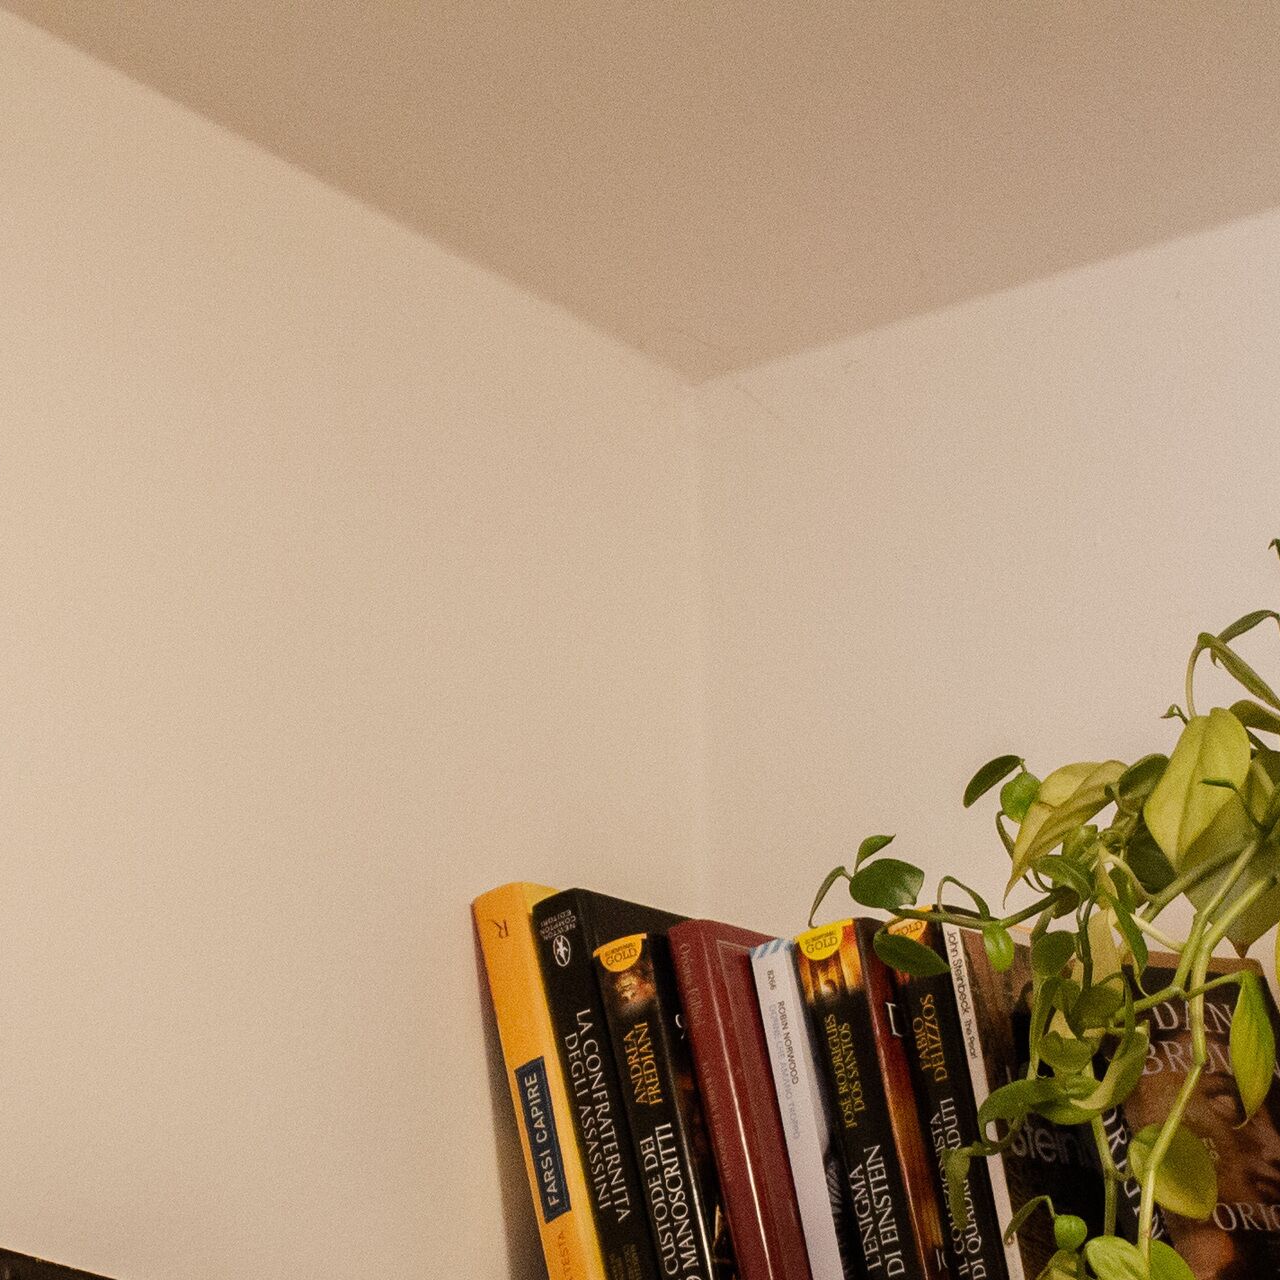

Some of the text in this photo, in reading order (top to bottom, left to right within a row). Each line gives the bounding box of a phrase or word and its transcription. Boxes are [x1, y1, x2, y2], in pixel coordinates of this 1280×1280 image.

[540, 916, 576, 935] COMPTON
[606, 946, 638, 966] GOLD
[806, 936, 838, 954] GOLD
[947, 931, 958, 957] John
[767, 969, 777, 991] 8266
[952, 958, 970, 1014] Steinbeck
[577, 1008, 594, 1036] LA
[777, 1001, 799, 1085] ROBIN NORWOOD
[824, 1013, 849, 1095] RODRIGUES
[913, 1017, 932, 1071] FABIO
[920, 993, 948, 1082] DELIZZOS
[623, 1030, 648, 1103] ANDREA
[634, 1022, 663, 1105] FREDIANI
[838, 1022, 865, 1113] DOS SANTOS
[524, 1072, 560, 1206] FARSI CAPIRE
[565, 1032, 612, 1209] DEGLI ASSASSINI
[583, 1039, 631, 1222] CONFRATERNITA
[639, 1135, 659, 1172] DEI
[648, 1174, 679, 1275] CUSTODE
[655, 1122, 699, 1270] MANOSCRITTI
[849, 1163, 882, 1271] L'ENIGMA
[863, 1144, 906, 1277] DI EINSTEIN
[558, 1231, 571, 1276] TESTA
[959, 1258, 970, 1276] IL
[971, 1258, 987, 1280] DI
